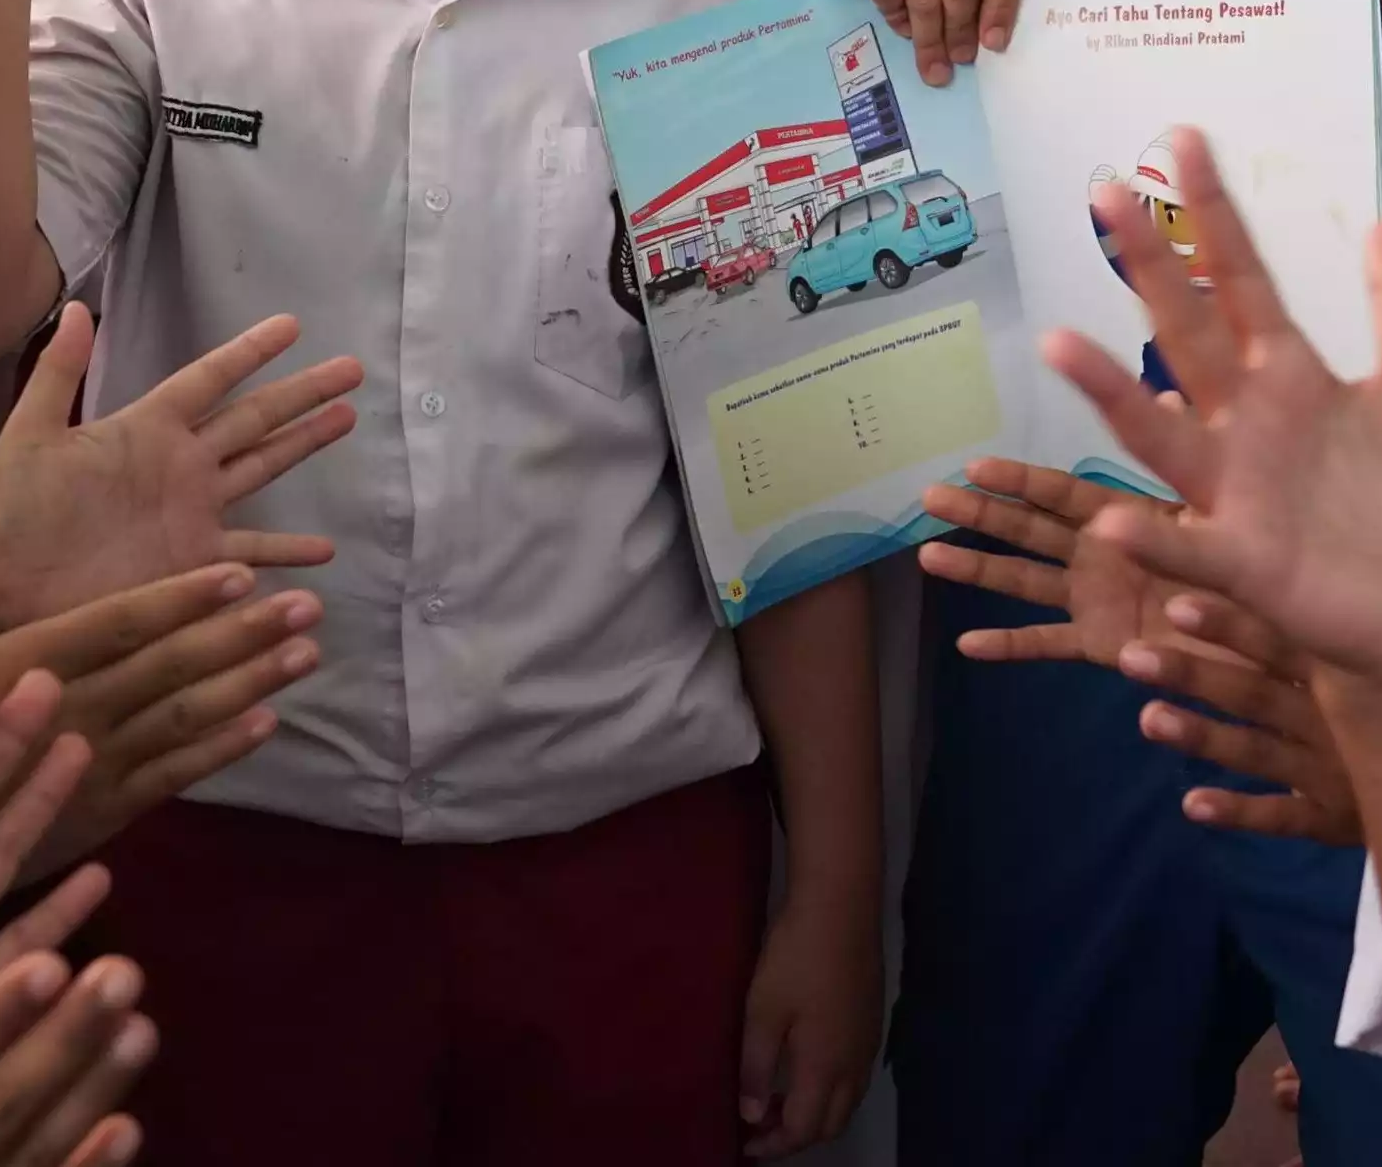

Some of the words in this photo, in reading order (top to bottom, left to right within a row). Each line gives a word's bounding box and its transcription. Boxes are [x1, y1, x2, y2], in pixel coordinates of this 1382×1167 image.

[1046, 8, 1072, 29] Ayo
[1078, 6, 1108, 22] Cari
[1114, 5, 1148, 21] Tahu
[1154, 4, 1213, 23] Tentang
[1219, 0, 1285, 18] Pesawat!
[646, 57, 667, 73] kita
[671, 42, 717, 65] mengenal
[721, 28, 755, 52] produk
[1087, 37, 1100, 51] by
[1143, 32, 1193, 47] Rindiani
[1198, 31, 1245, 44] Pratami
[850, 346, 880, 362] Pertamina
